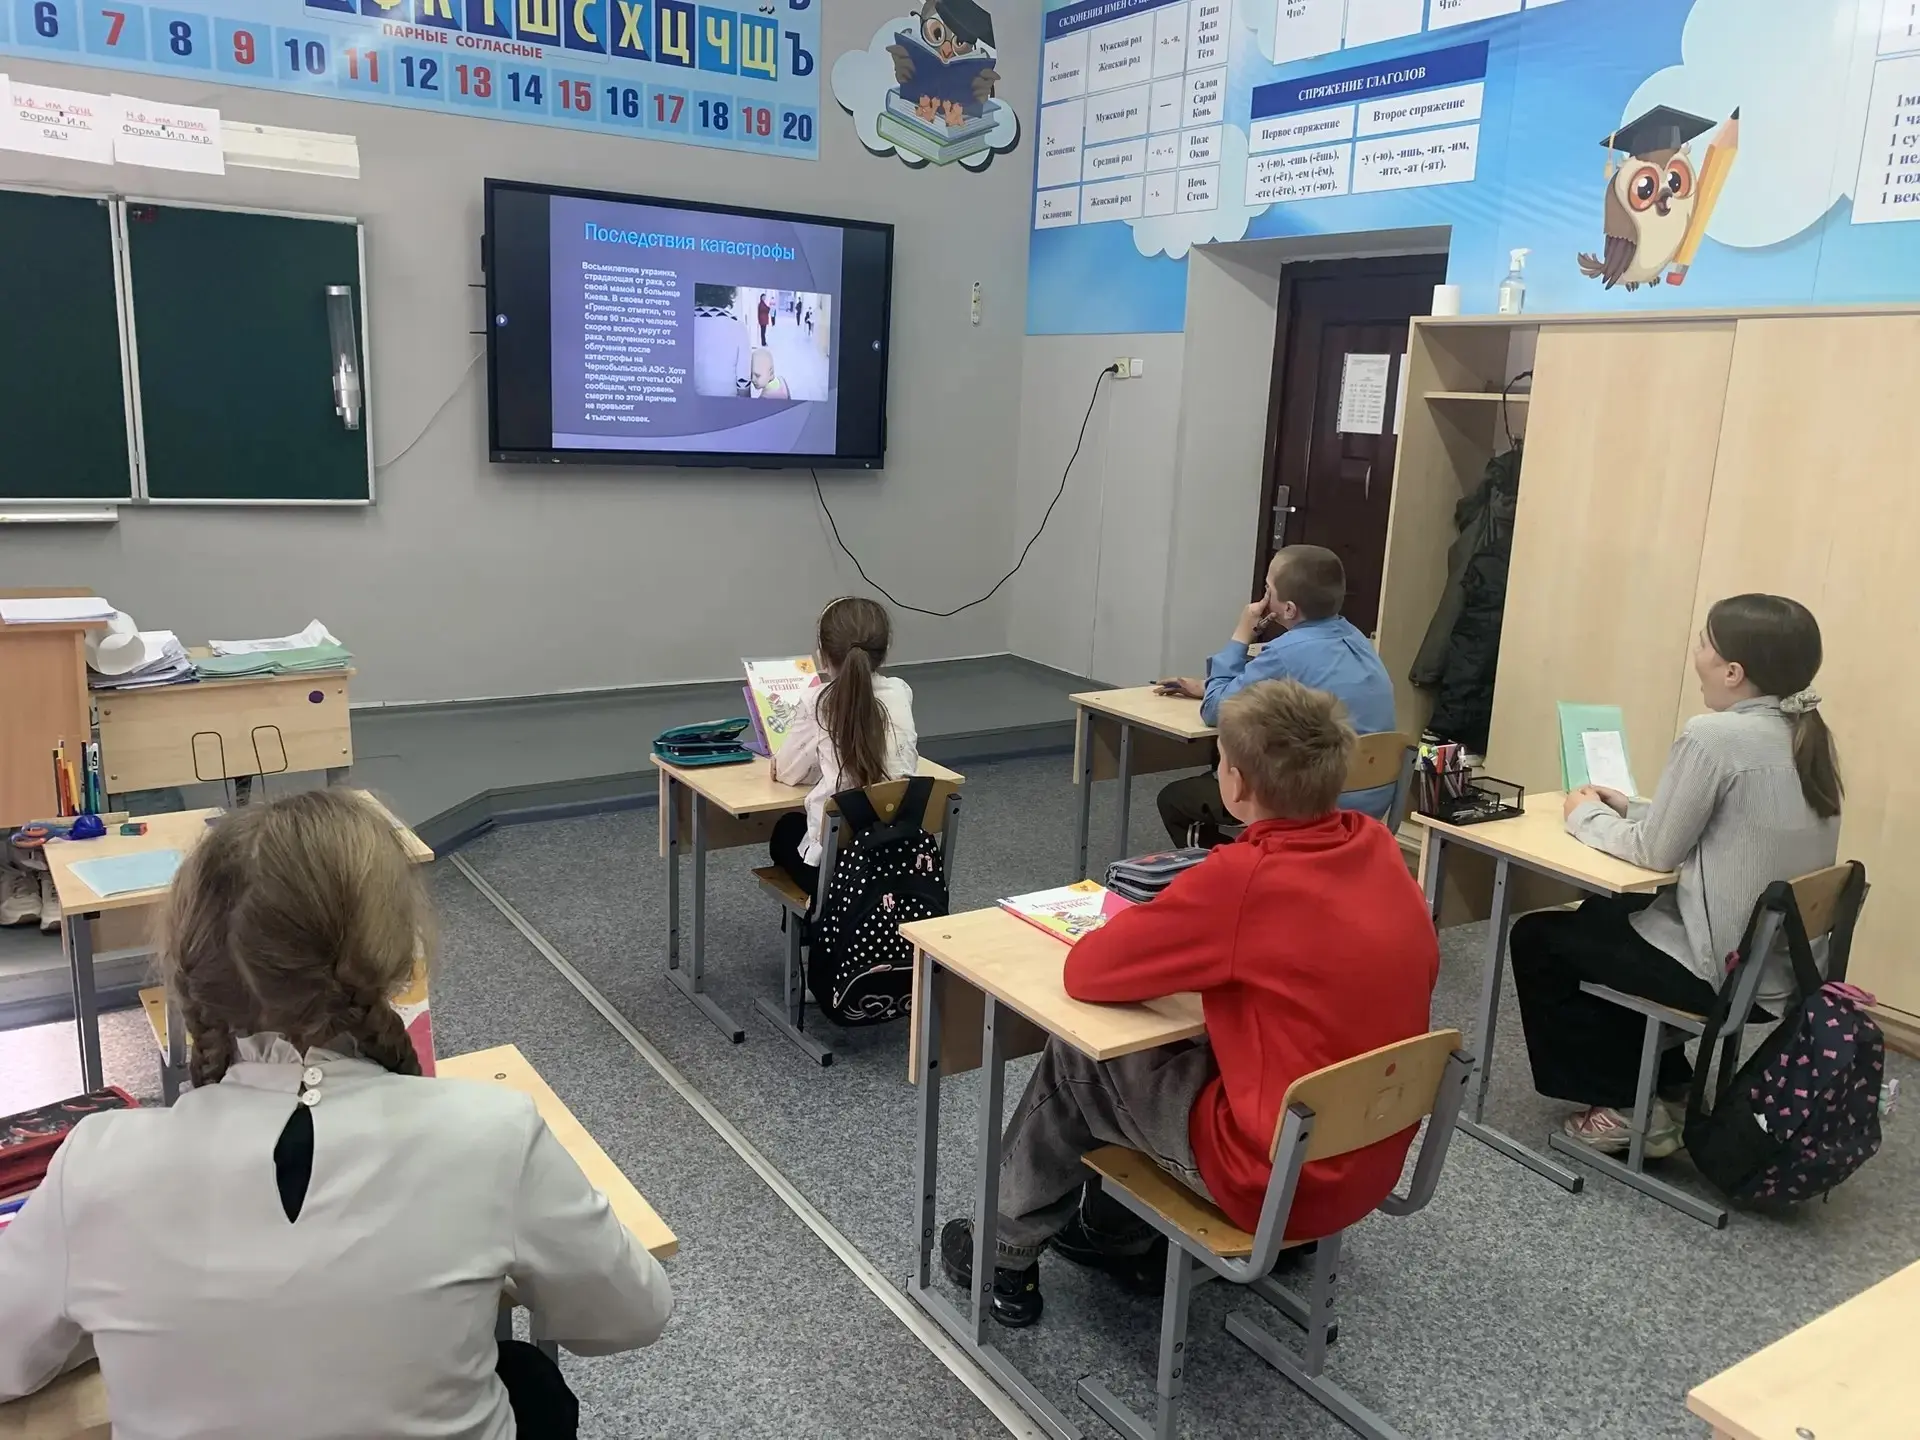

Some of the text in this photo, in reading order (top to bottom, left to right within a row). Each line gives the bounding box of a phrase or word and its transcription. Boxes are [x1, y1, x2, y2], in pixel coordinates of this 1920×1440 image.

[1058, 6, 1103, 28] СКЛОНЕНИЯ
[383, 23, 542, 59] ПАРНЫЕ СОГЛАСНЫЕ
[574, 0, 597, 43] С
[619, 1, 644, 50] Х
[662, 8, 689, 64] Ц
[706, 16, 730, 65] Ч
[741, 23, 776, 78] Щ
[1099, 35, 1143, 54] Мужской род
[1198, 34, 1220, 45] Мама
[1098, 56, 1141, 72] Женский род
[34, 2, 812, 142] 6 7 8 9 10 11 12 13 14 15 16 17 18 19 20
[1050, 68, 1080, 82] склонение
[1194, 79, 1218, 91] Салон
[1298, 66, 1426, 102] СПРЯЖЕНИЕ ГЛАГОЛОВ
[1193, 92, 1217, 105] Сарай
[20, 110, 60, 123] Форма
[1096, 108, 1138, 124] Мужской род
[1192, 107, 1211, 118] Конь
[1373, 99, 1465, 122] Второе спряжение
[1892, 114, 1899, 127] 1
[122, 124, 160, 137] Форма
[1261, 119, 1341, 140] Первое спряжение
[1190, 135, 1209, 146] Поле
[1890, 133, 1896, 146] 1
[1046, 146, 1076, 157] склонение
[1189, 149, 1210, 159] Окно
[1092, 154, 1133, 168] Средний род
[1887, 152, 1893, 166] 1
[1188, 178, 1207, 188] Ночь
[1884, 172, 1891, 185] 1
[1090, 194, 1132, 207] Женский род
[1187, 192, 1210, 202] Степь
[1881, 192, 1887, 204] 1
[1042, 209, 1073, 220] склонение
[584, 222, 795, 261] Последствия катастрофы
[581, 261, 677, 279] Восьмилетняя украинка,
[584, 273, 634, 284] страдающая
[645, 278, 665, 287] рака,
[584, 283, 608, 291] своей
[609, 285, 635, 293] мамой
[643, 287, 680, 298] больнице
[611, 294, 618, 302] В
[619, 296, 644, 304] своем
[645, 298, 670, 306] отчете
[627, 307, 661, 316] отметил,
[663, 309, 676, 317] что
[584, 312, 679, 327] более 90 тысяч человек,
[584, 323, 612, 332] скорее
[613, 325, 637, 334] всего,
[638, 327, 661, 336] умрут
[584, 334, 605, 342] рака,
[606, 335, 655, 345] полученного
[584, 342, 627, 352] облучения
[584, 353, 632, 363] катастрофы
[584, 362, 647, 373] Чернобыльской
[668, 366, 686, 374] Хотя
[584, 373, 635, 382] предыдущие
[665, 376, 683, 384] ООН
[584, 382, 627, 392] сообщали,
[584, 392, 613, 400] смерти
[596, 403, 635, 411] превысит
[617, 415, 650, 423] человек.
